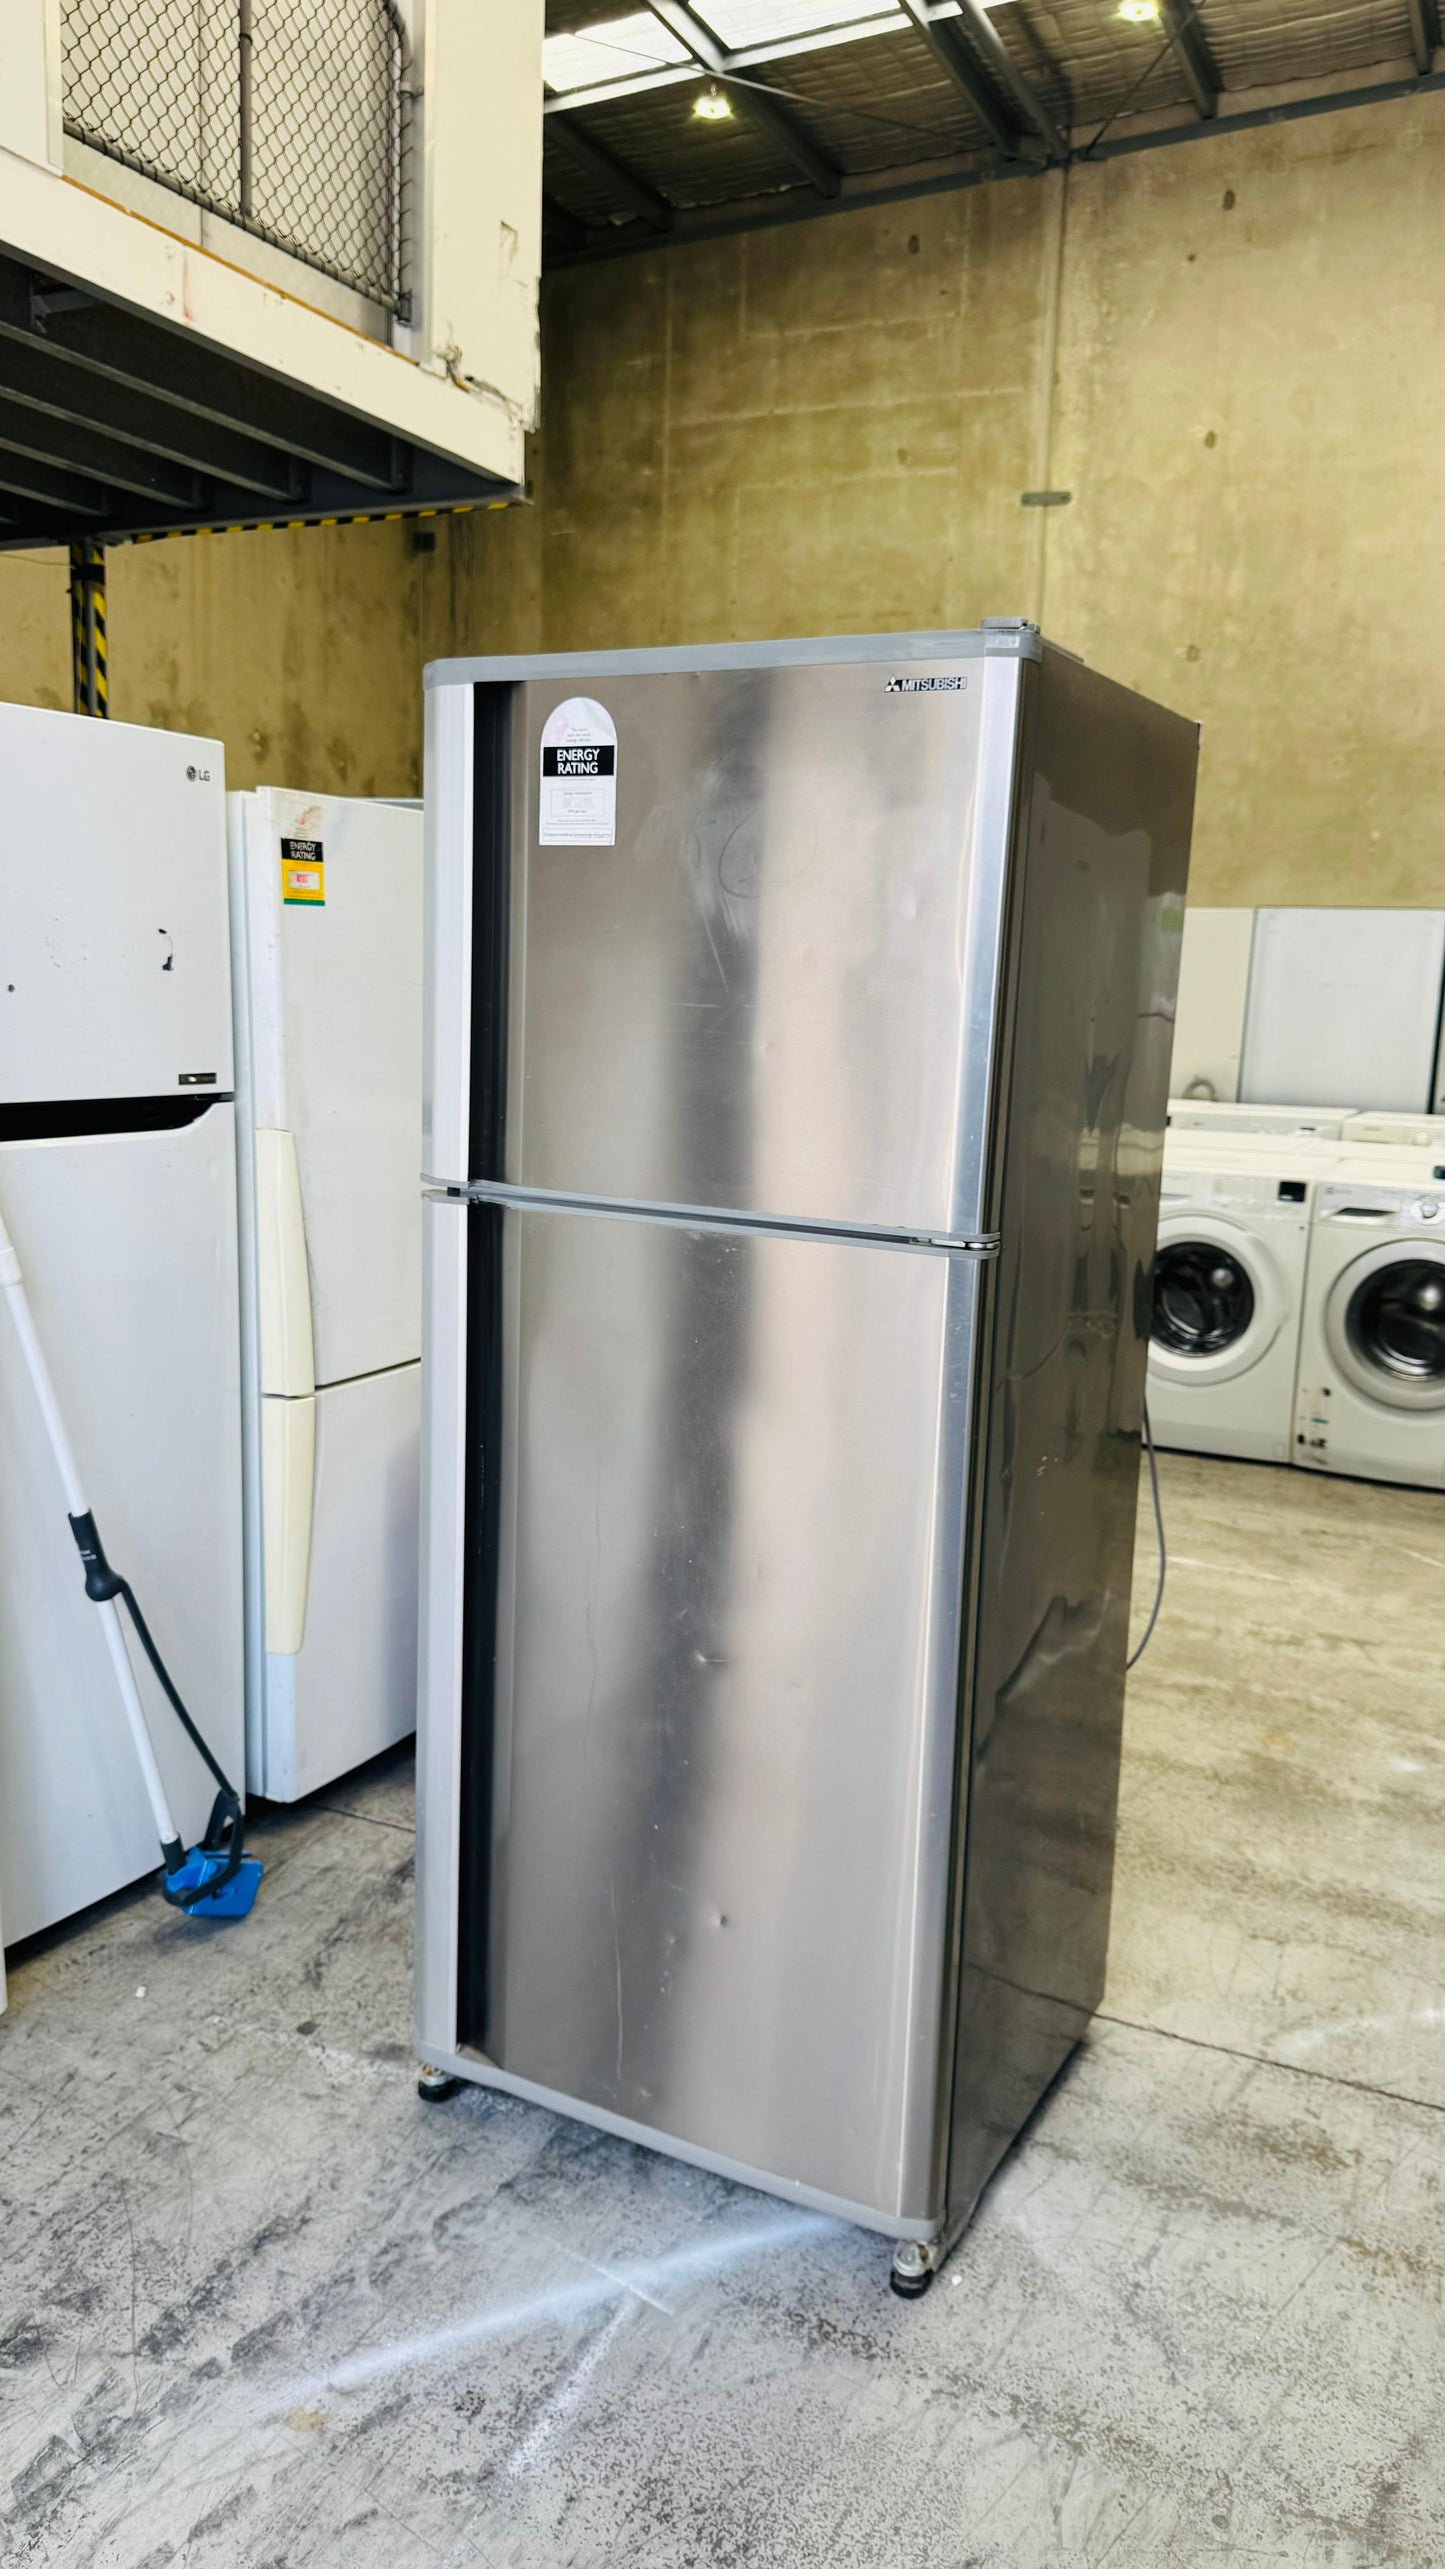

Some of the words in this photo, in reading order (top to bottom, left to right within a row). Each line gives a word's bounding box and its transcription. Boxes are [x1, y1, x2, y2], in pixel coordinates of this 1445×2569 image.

[901, 677, 966, 691] MITSUBISHI
[557, 749, 600, 761] ENERGY
[198, 768, 210, 782] LG
[557, 761, 599, 775] RATING
[290, 841, 316, 851] ENERGY
